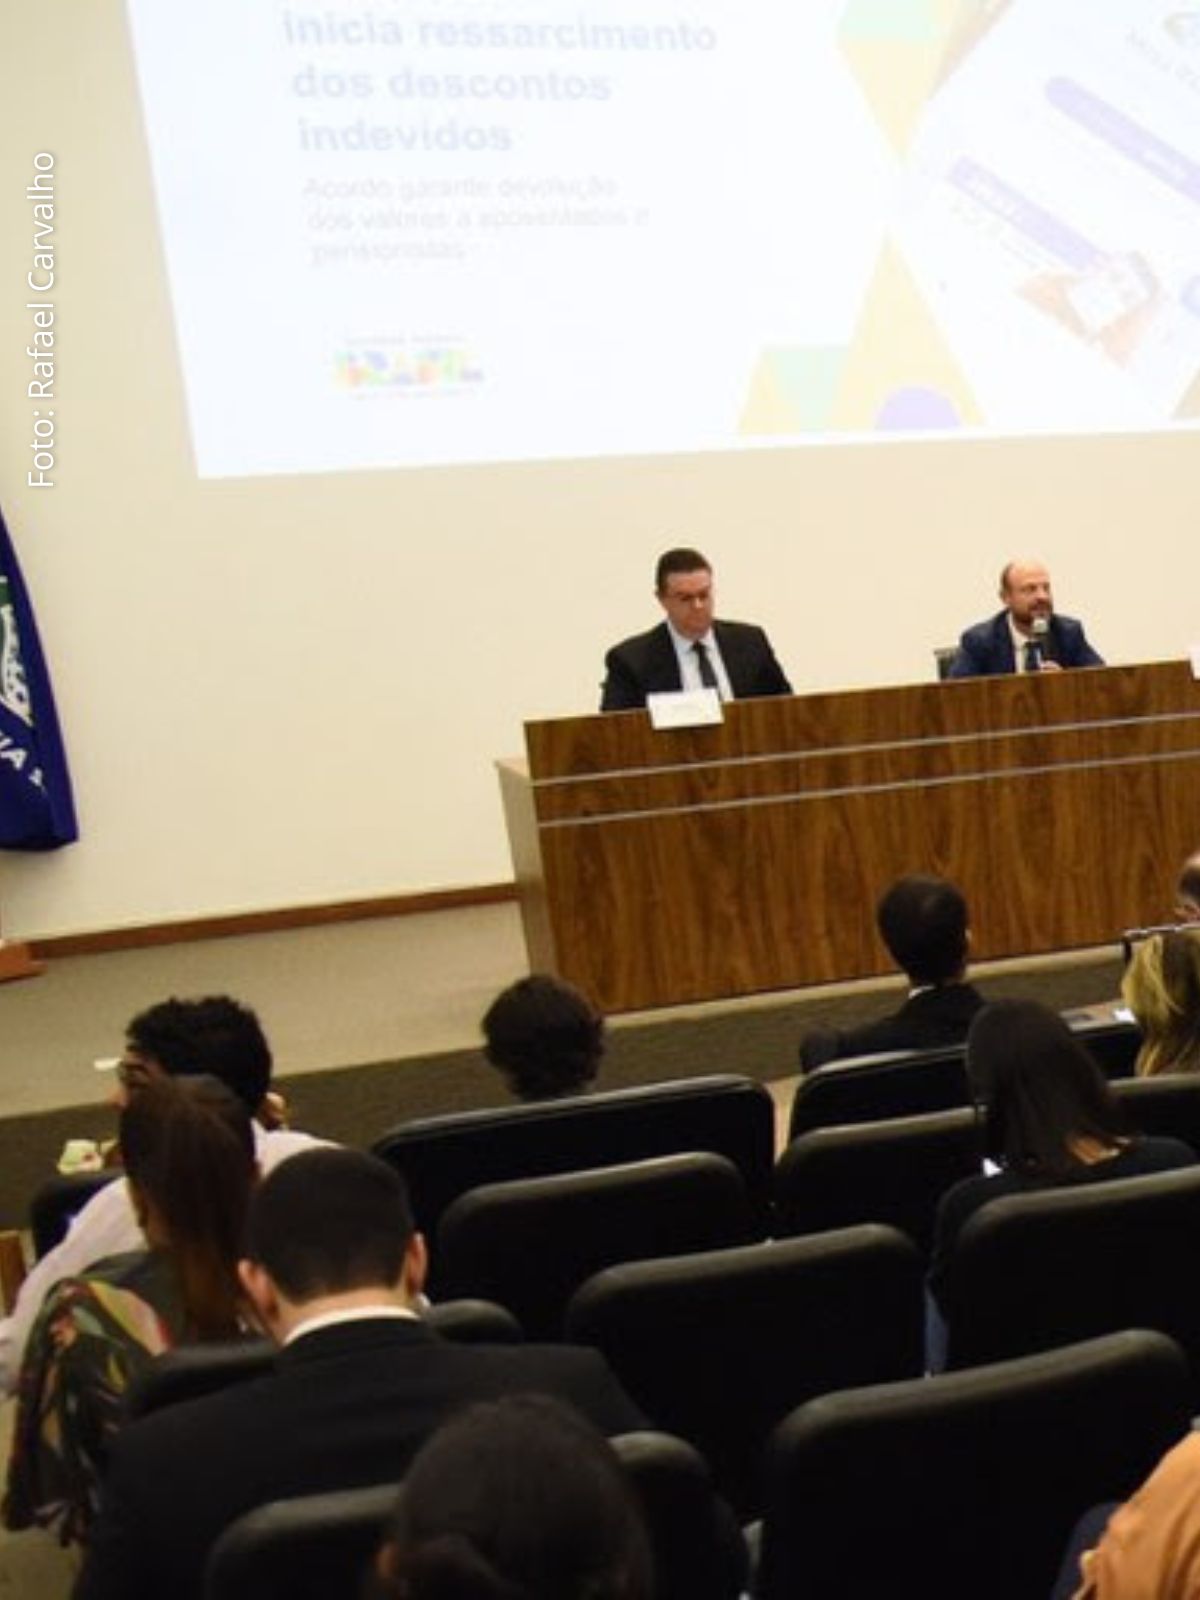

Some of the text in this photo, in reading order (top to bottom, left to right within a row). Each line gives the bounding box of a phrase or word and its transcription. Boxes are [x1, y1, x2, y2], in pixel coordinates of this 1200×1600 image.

[281, 11, 718, 52] inicia ressarcimento
[292, 64, 613, 102] dos descontos
[299, 118, 514, 152] indevidos
